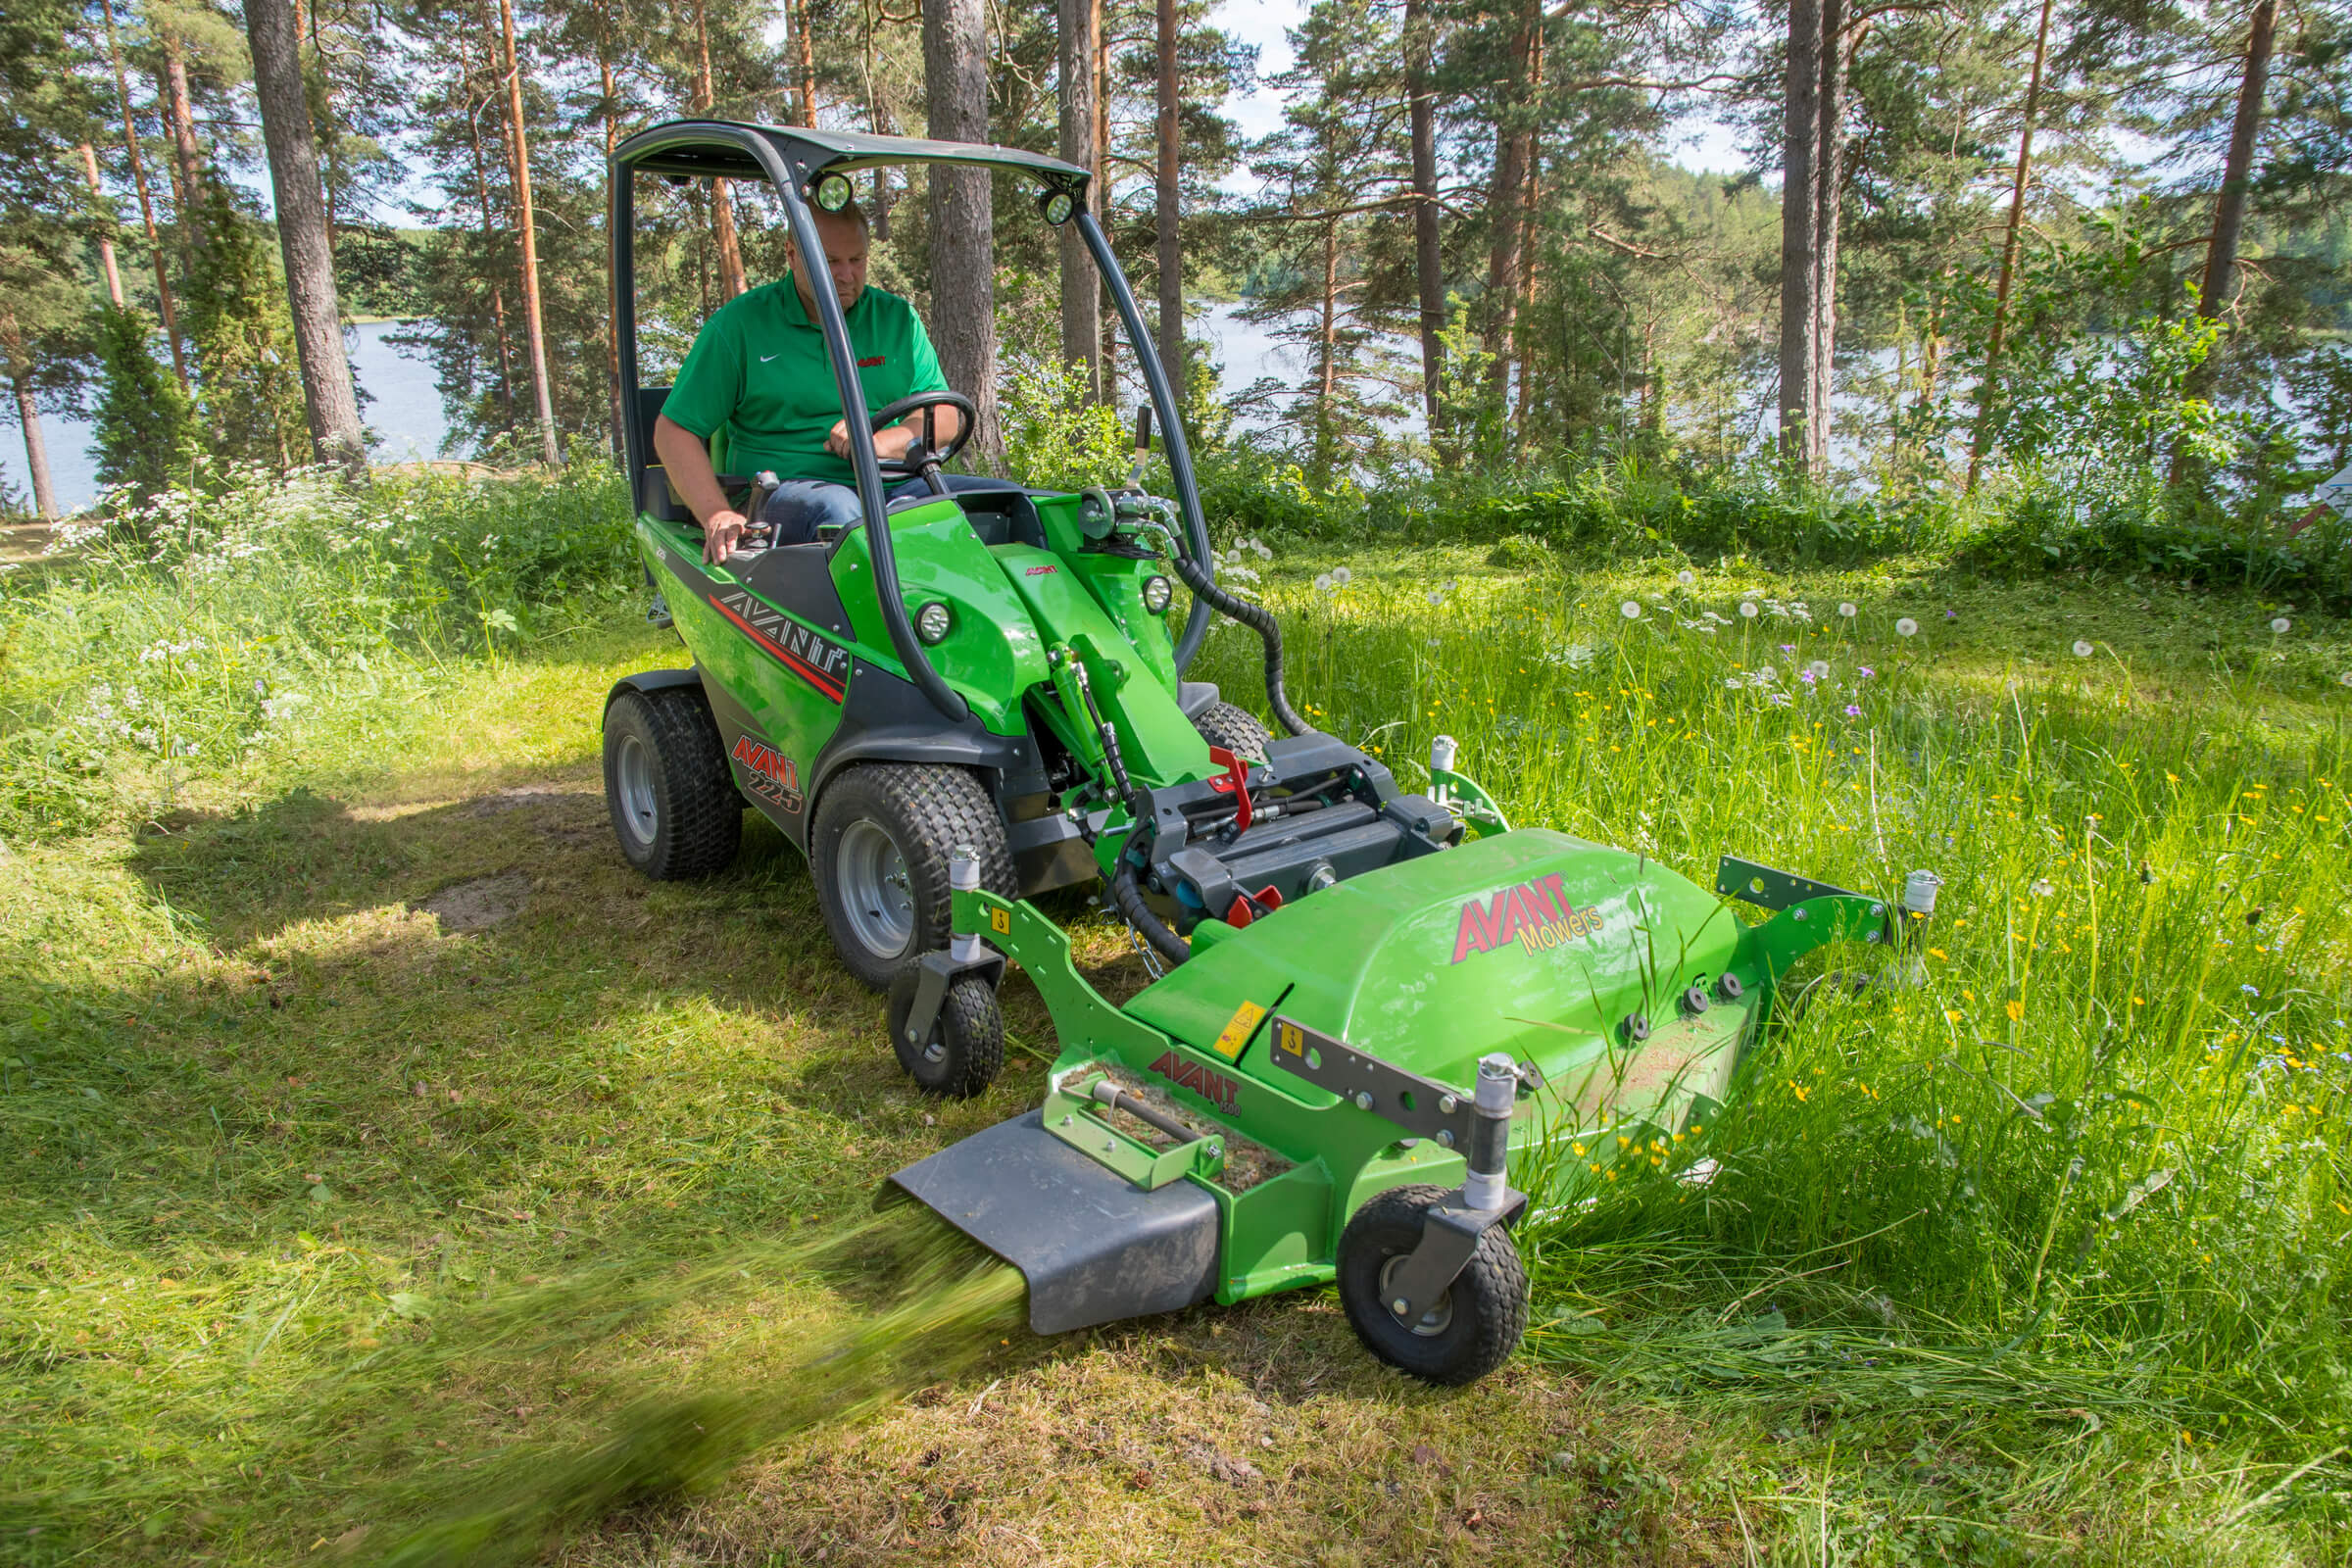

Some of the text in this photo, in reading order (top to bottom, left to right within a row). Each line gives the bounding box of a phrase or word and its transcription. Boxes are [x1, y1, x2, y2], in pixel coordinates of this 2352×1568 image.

[720, 591, 848, 673] AVANT
[731, 735, 799, 792] AVANT
[747, 771, 803, 814] 225
[1450, 871, 1574, 965] AVANT
[1517, 906, 1603, 956] Mowers
[1147, 1050, 1240, 1105] AVANT
